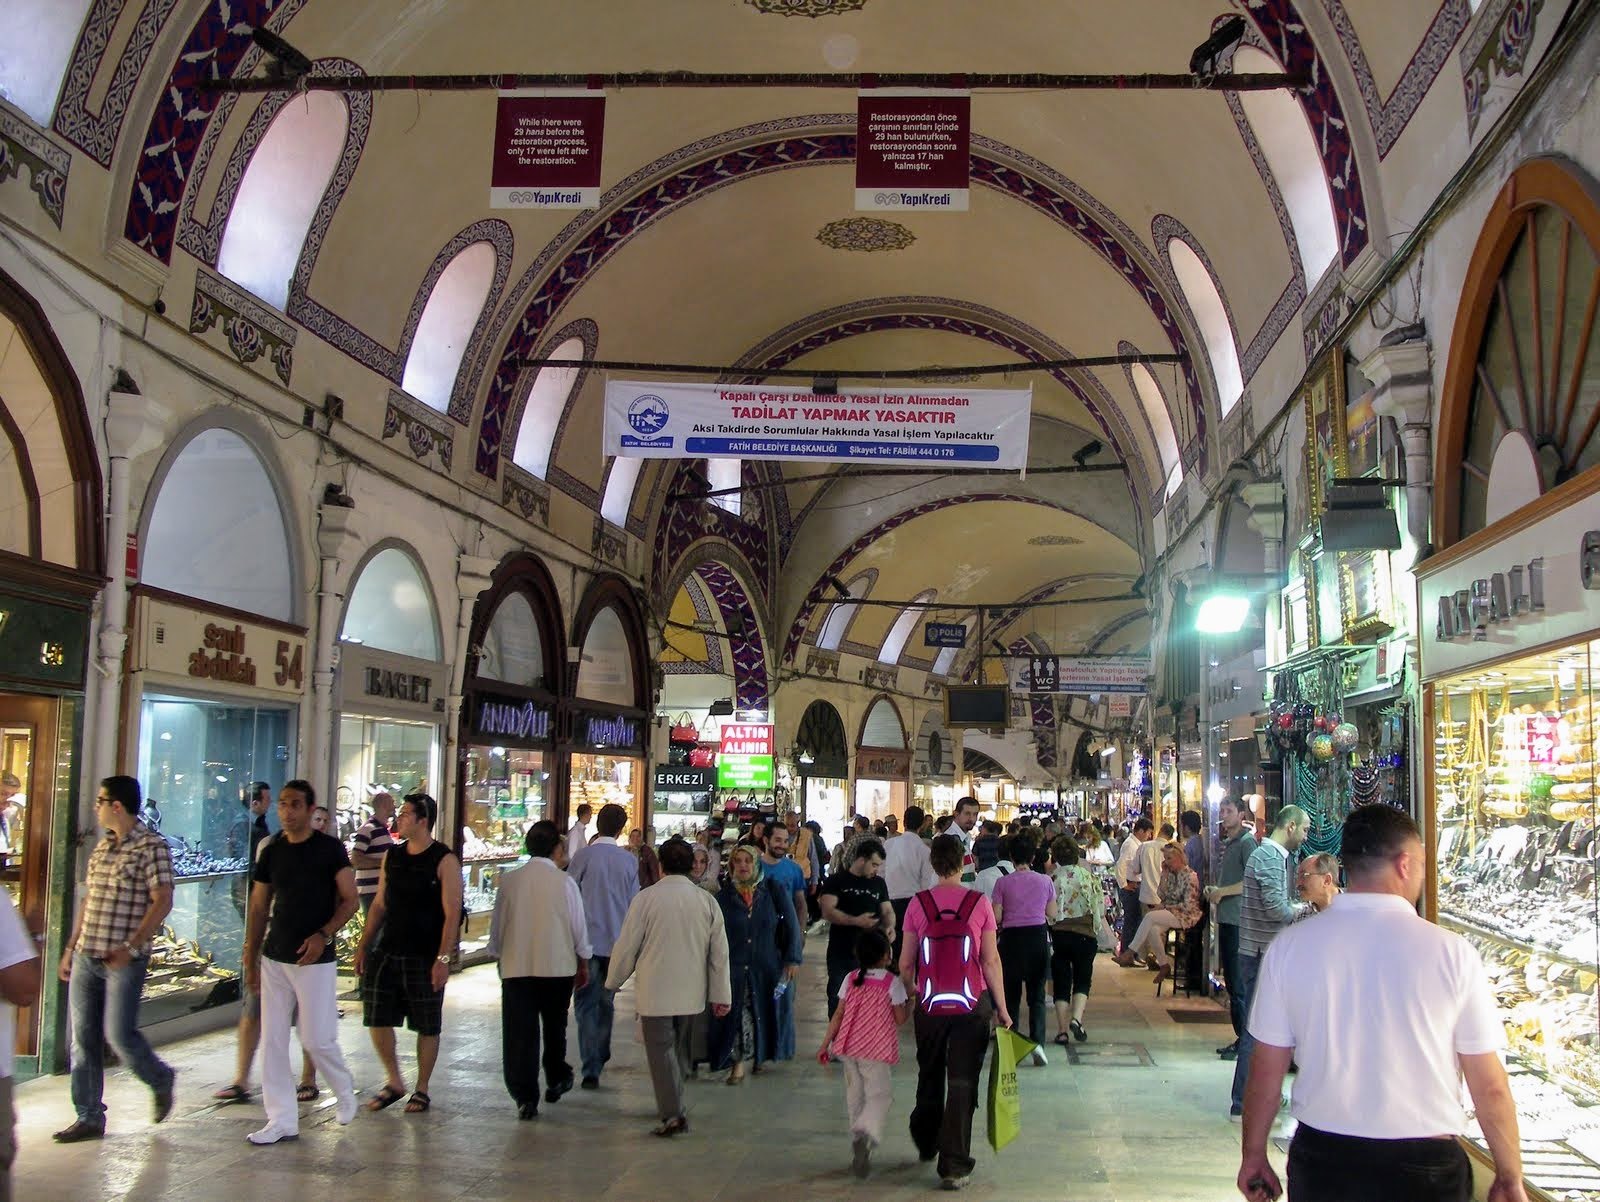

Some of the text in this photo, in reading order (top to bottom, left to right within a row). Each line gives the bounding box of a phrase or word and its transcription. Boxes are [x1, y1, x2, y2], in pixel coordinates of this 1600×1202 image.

[518, 118, 540, 126] While
[542, 118, 561, 126] there
[870, 113, 935, 122] Restorasyondan
[525, 128, 544, 136] hans
[546, 128, 570, 136] before
[572, 128, 585, 136] the
[868, 124, 901, 132] çarşının
[875, 133, 885, 141] 29
[887, 133, 902, 141] han
[510, 138, 587, 147] restoration process,
[869, 142, 932, 152] restorasyondan
[507, 147, 524, 156] only
[526, 147, 536, 155] 17
[557, 147, 569, 155] left
[571, 147, 589, 155] after
[518, 157, 577, 165] the restoration.
[882, 152, 944, 161] yalnızca 17 han
[894, 162, 932, 171] kalmıştır.
[720, 391, 756, 402] Kapalı
[759, 392, 790, 404] Çarşı
[850, 394, 880, 404] Yasal
[883, 394, 904, 404] İzin
[907, 396, 969, 406] Alınmadan
[732, 405, 956, 424] TADİLAT YAPMAK YASAKTIR
[692, 424, 995, 441] Aksi Takdirde Sorumlular Hakkında Yasal İşlem Yapılacaktır
[728, 442, 955, 457] FATİH BELEDİYE BAŞKANLIĞI Şikayet Tel: FABİM 444 0 176
[939, 628, 963, 637] POLİS
[274, 639, 303, 689] 54
[365, 666, 432, 703] BAGET
[480, 701, 548, 738] ANADOLU
[725, 727, 768, 739] ALTIN
[725, 742, 768, 754] ALINIR
[654, 773, 704, 785] ERKEZİ
[708, 784, 714, 792] 2
